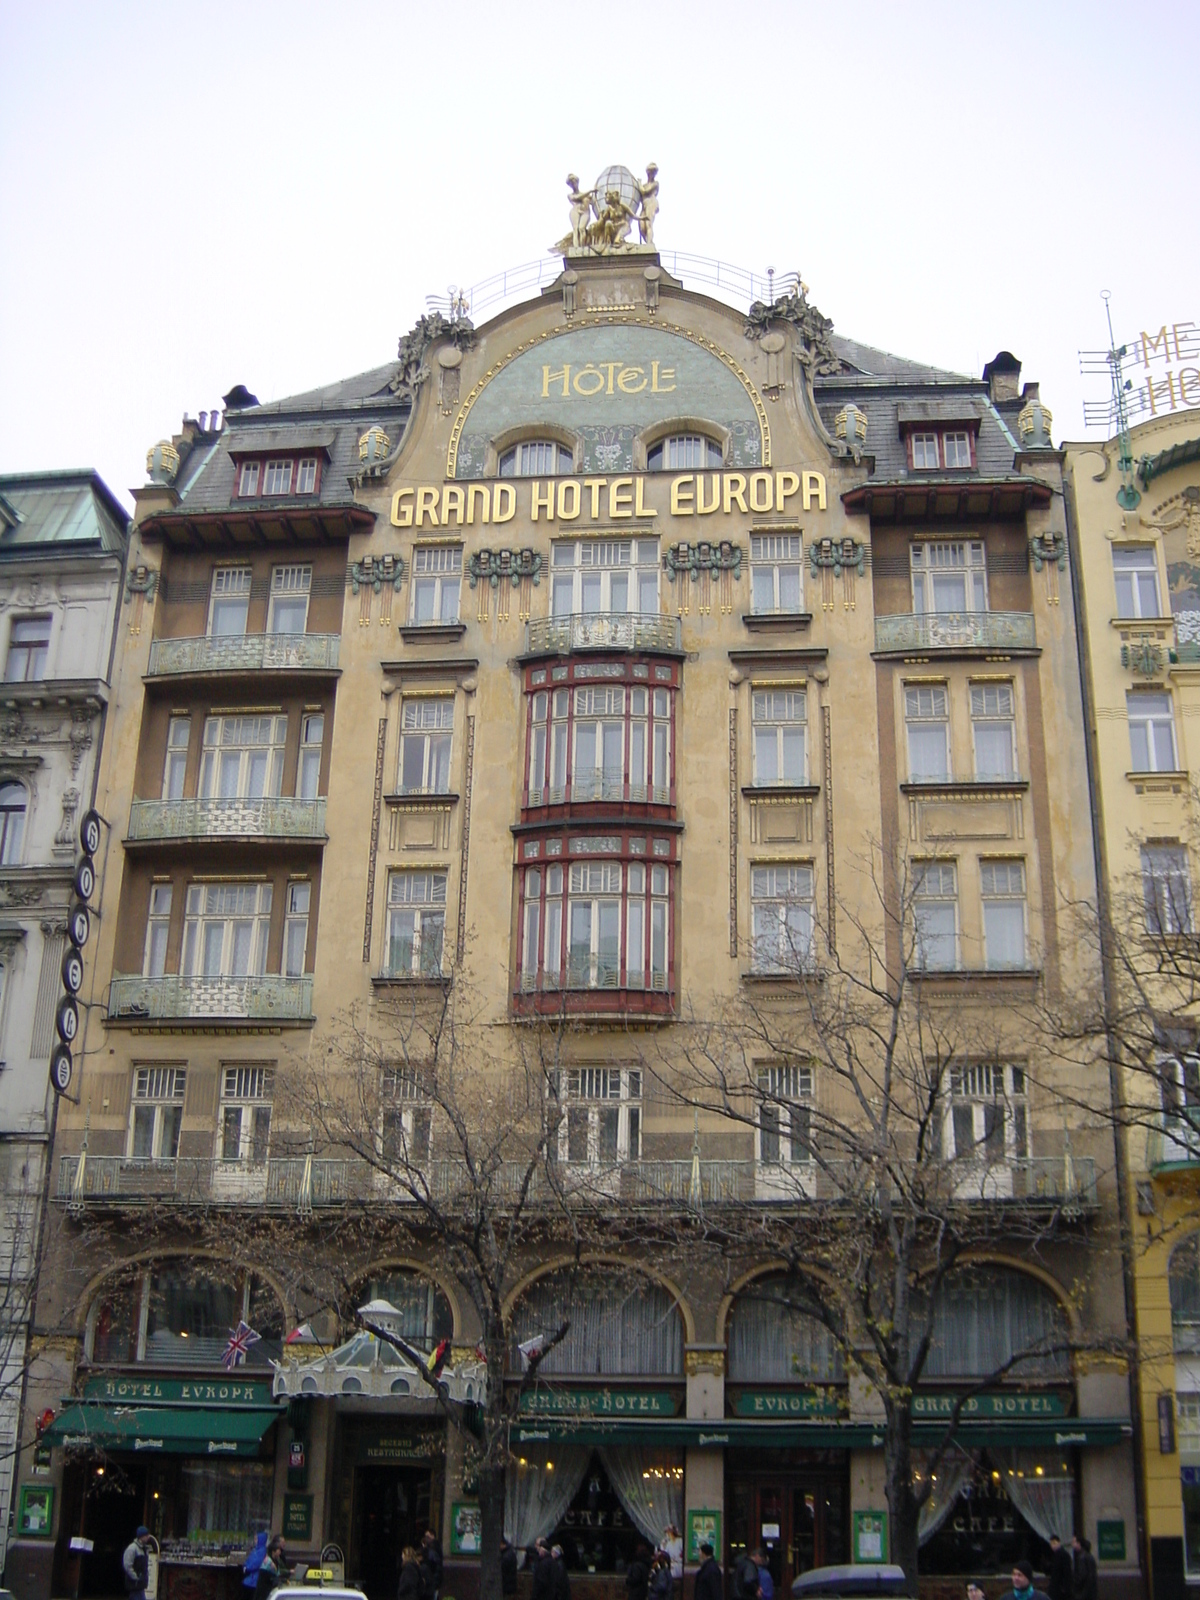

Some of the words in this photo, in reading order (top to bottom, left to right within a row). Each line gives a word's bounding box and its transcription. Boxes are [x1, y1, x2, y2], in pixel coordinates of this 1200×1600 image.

[390, 486, 517, 527] GRAND
[531, 477, 659, 521] HOTEL
[670, 470, 828, 516] EUROPA
[106, 1382, 163, 1398] HOTEL
[181, 1385, 255, 1401] EVROPA
[602, 1394, 661, 1411] HOTEL
[993, 1398, 1053, 1413] HOTEL
